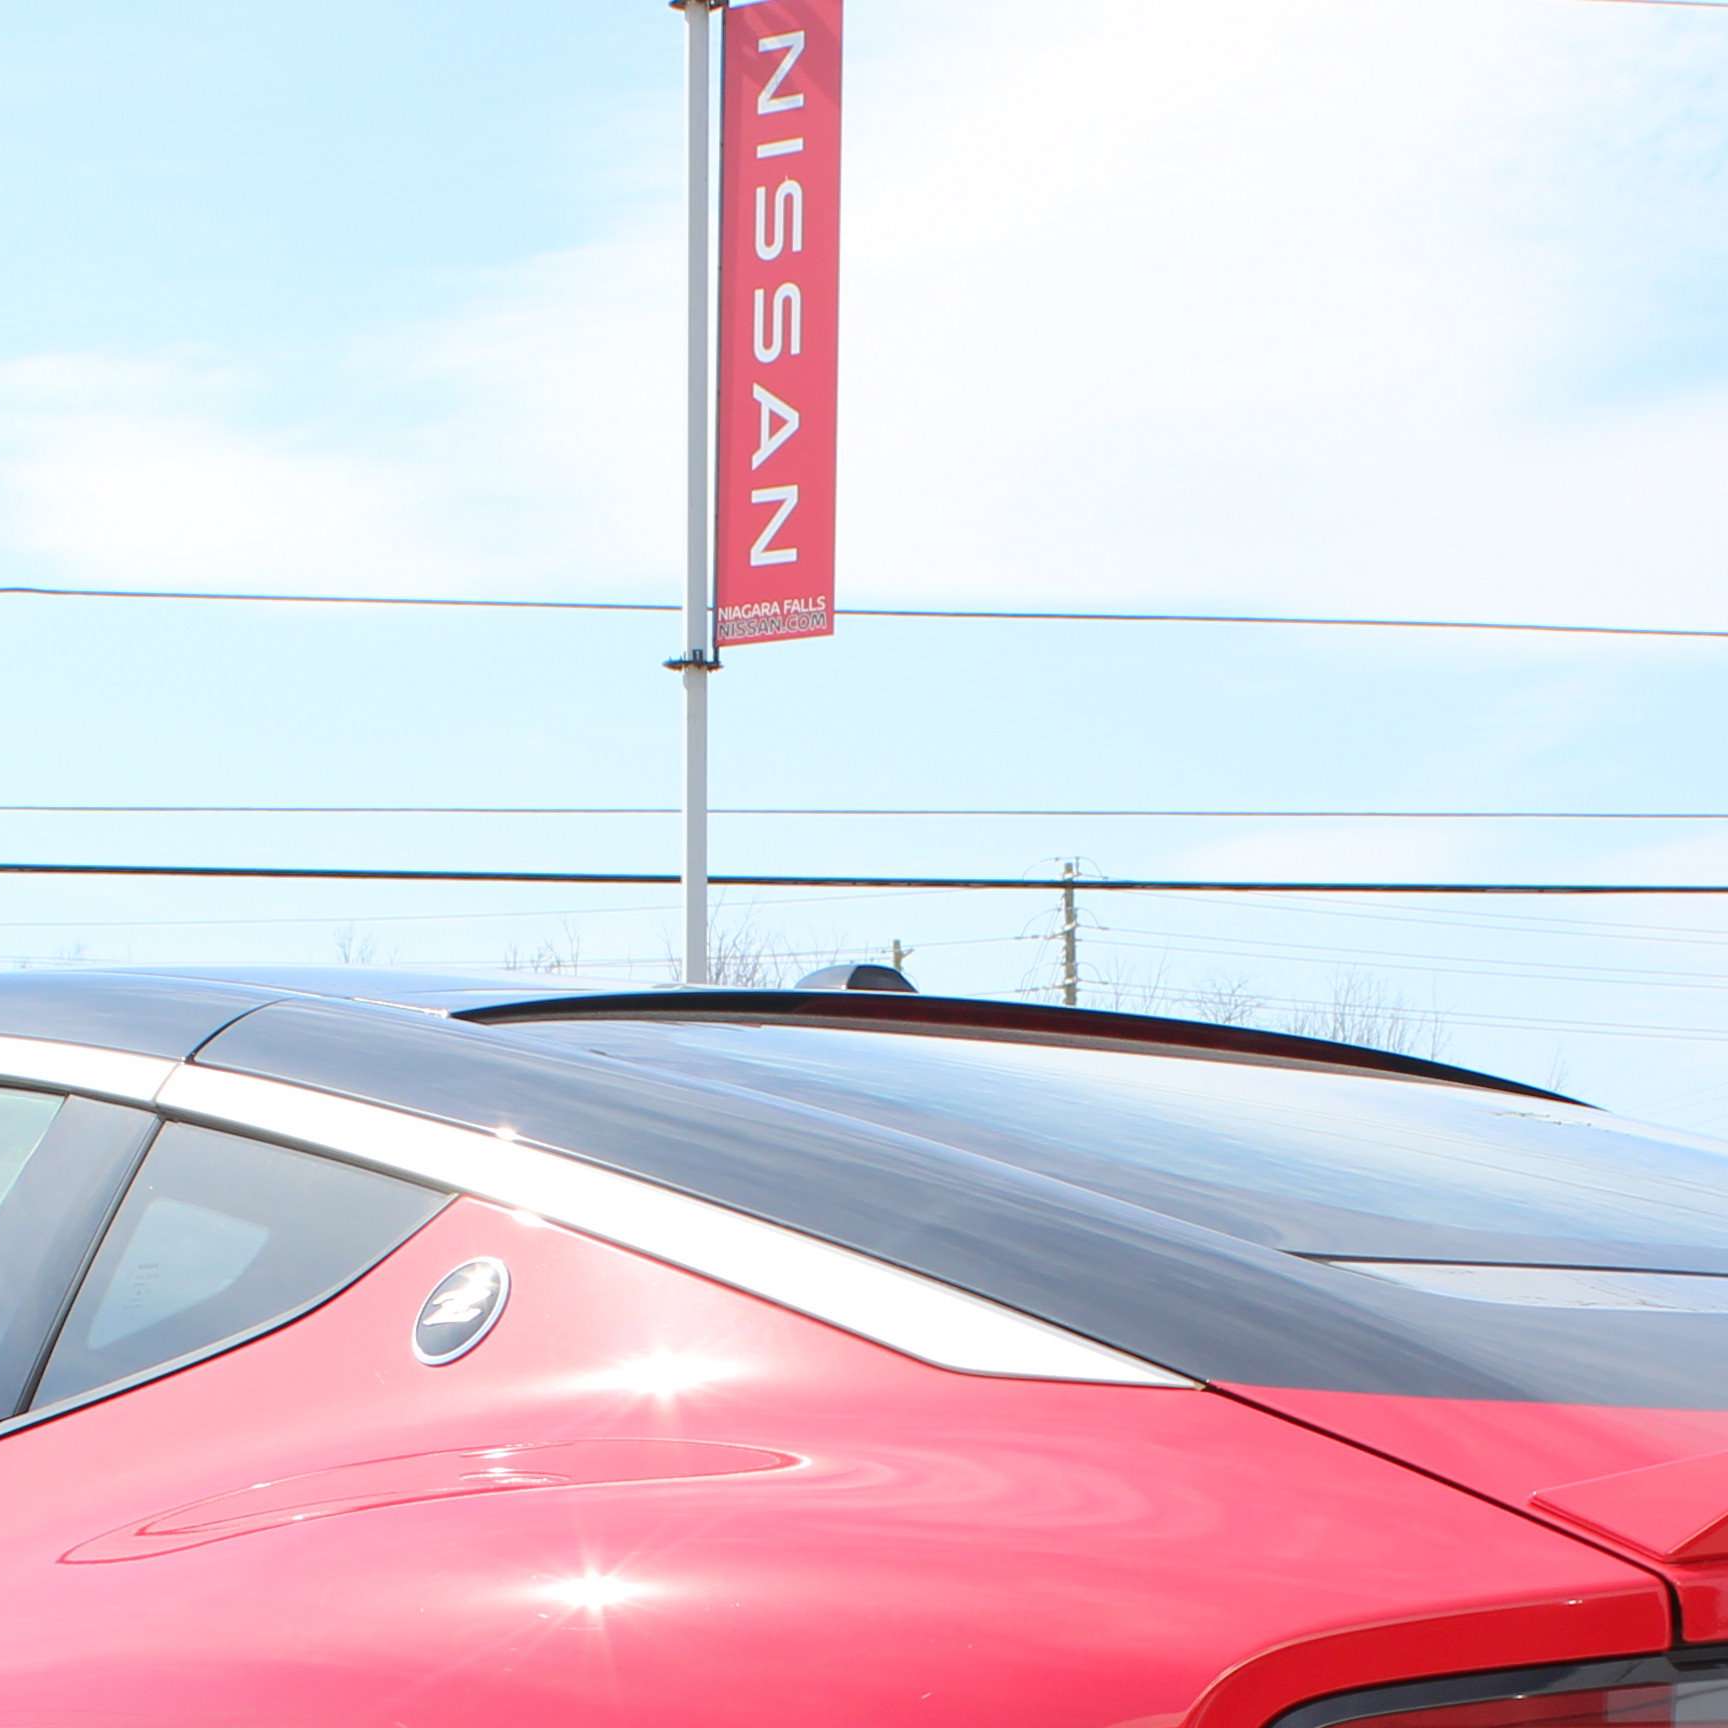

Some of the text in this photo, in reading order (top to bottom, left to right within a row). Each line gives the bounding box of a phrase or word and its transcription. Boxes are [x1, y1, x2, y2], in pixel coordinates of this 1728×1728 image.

[749, 30, 806, 567] NISSAN
[718, 595, 826, 621] NIAGARA FALLS
